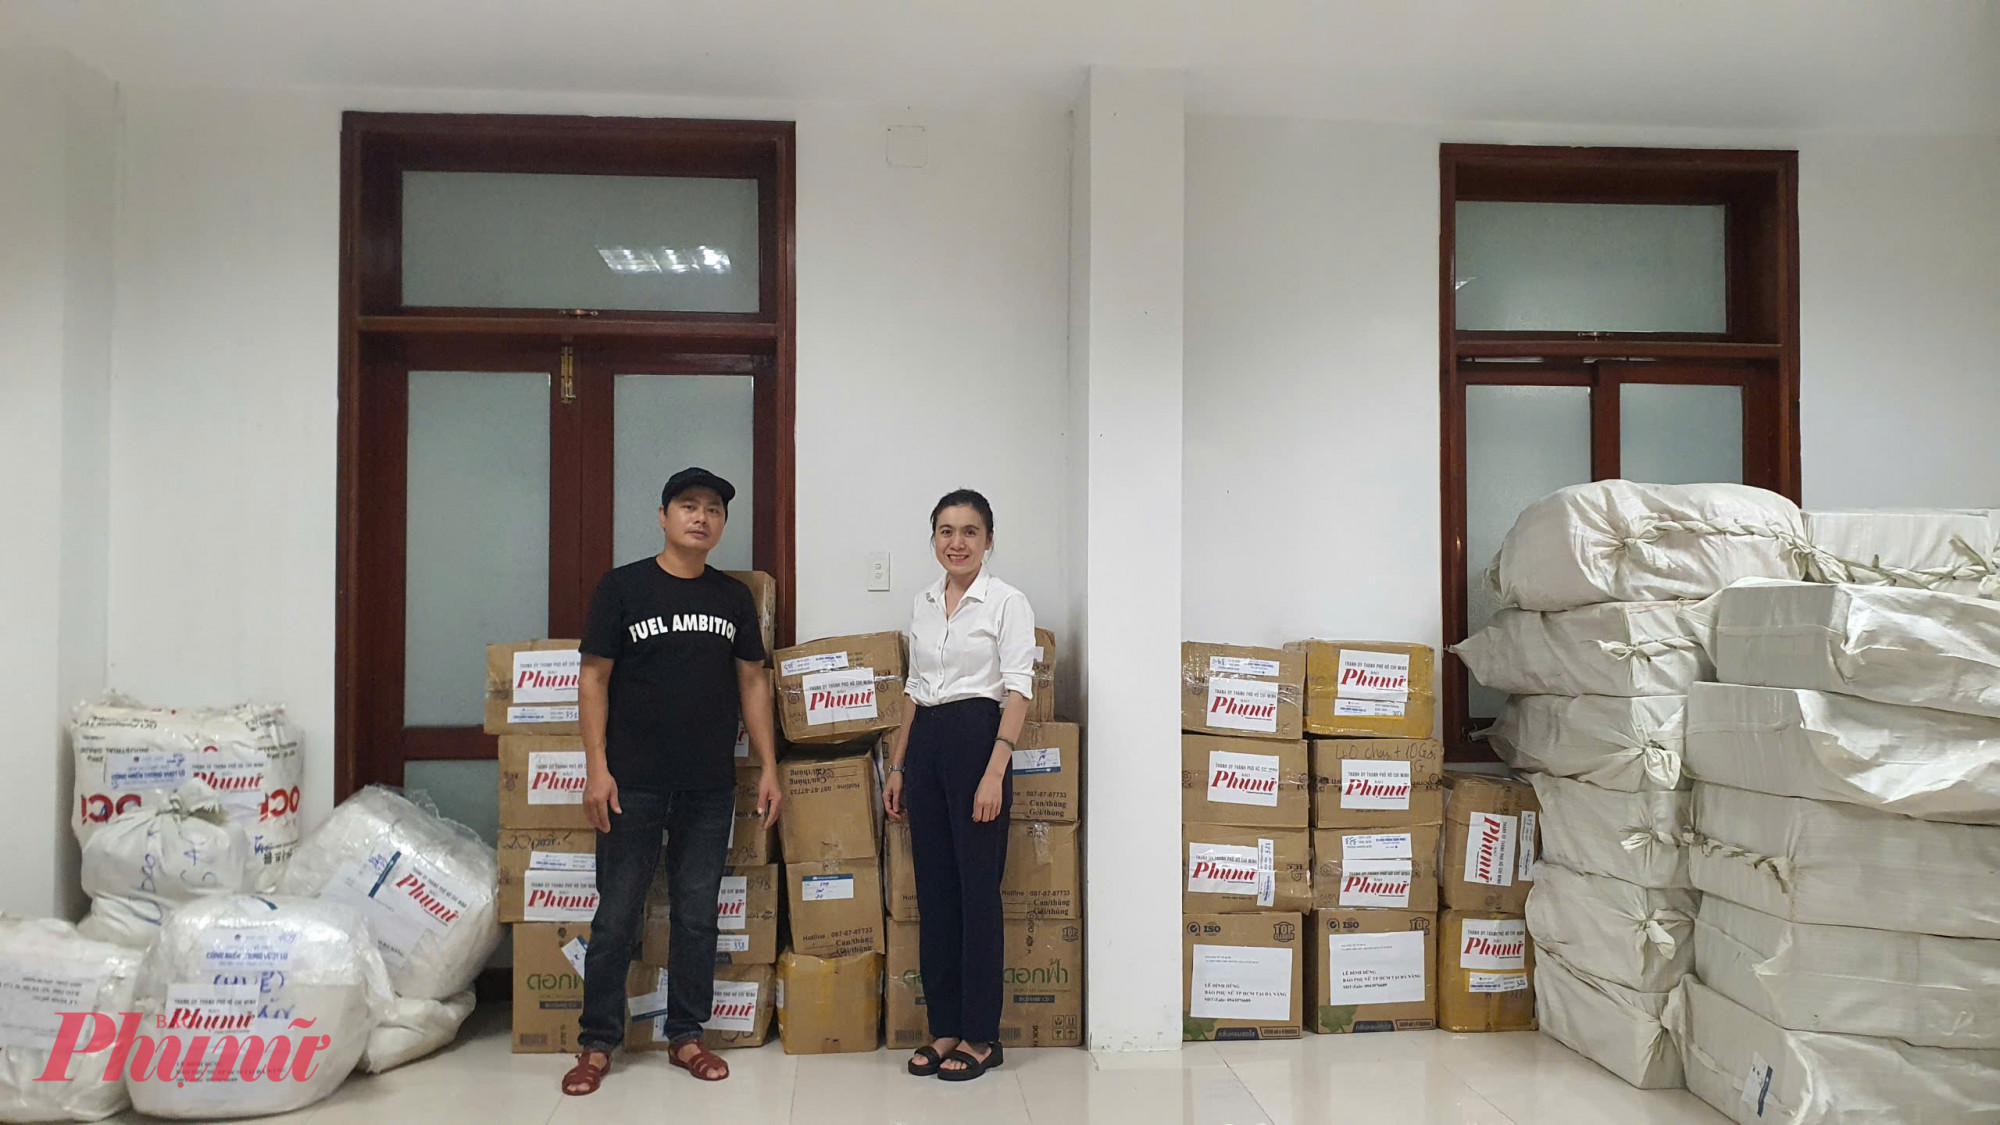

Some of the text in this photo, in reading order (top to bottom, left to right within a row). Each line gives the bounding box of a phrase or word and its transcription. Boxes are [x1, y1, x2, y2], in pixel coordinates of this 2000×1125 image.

[628, 616, 668, 642] FUEL
[1274, 925, 1295, 934] TOP
[1410, 920, 1430, 931] TOP
